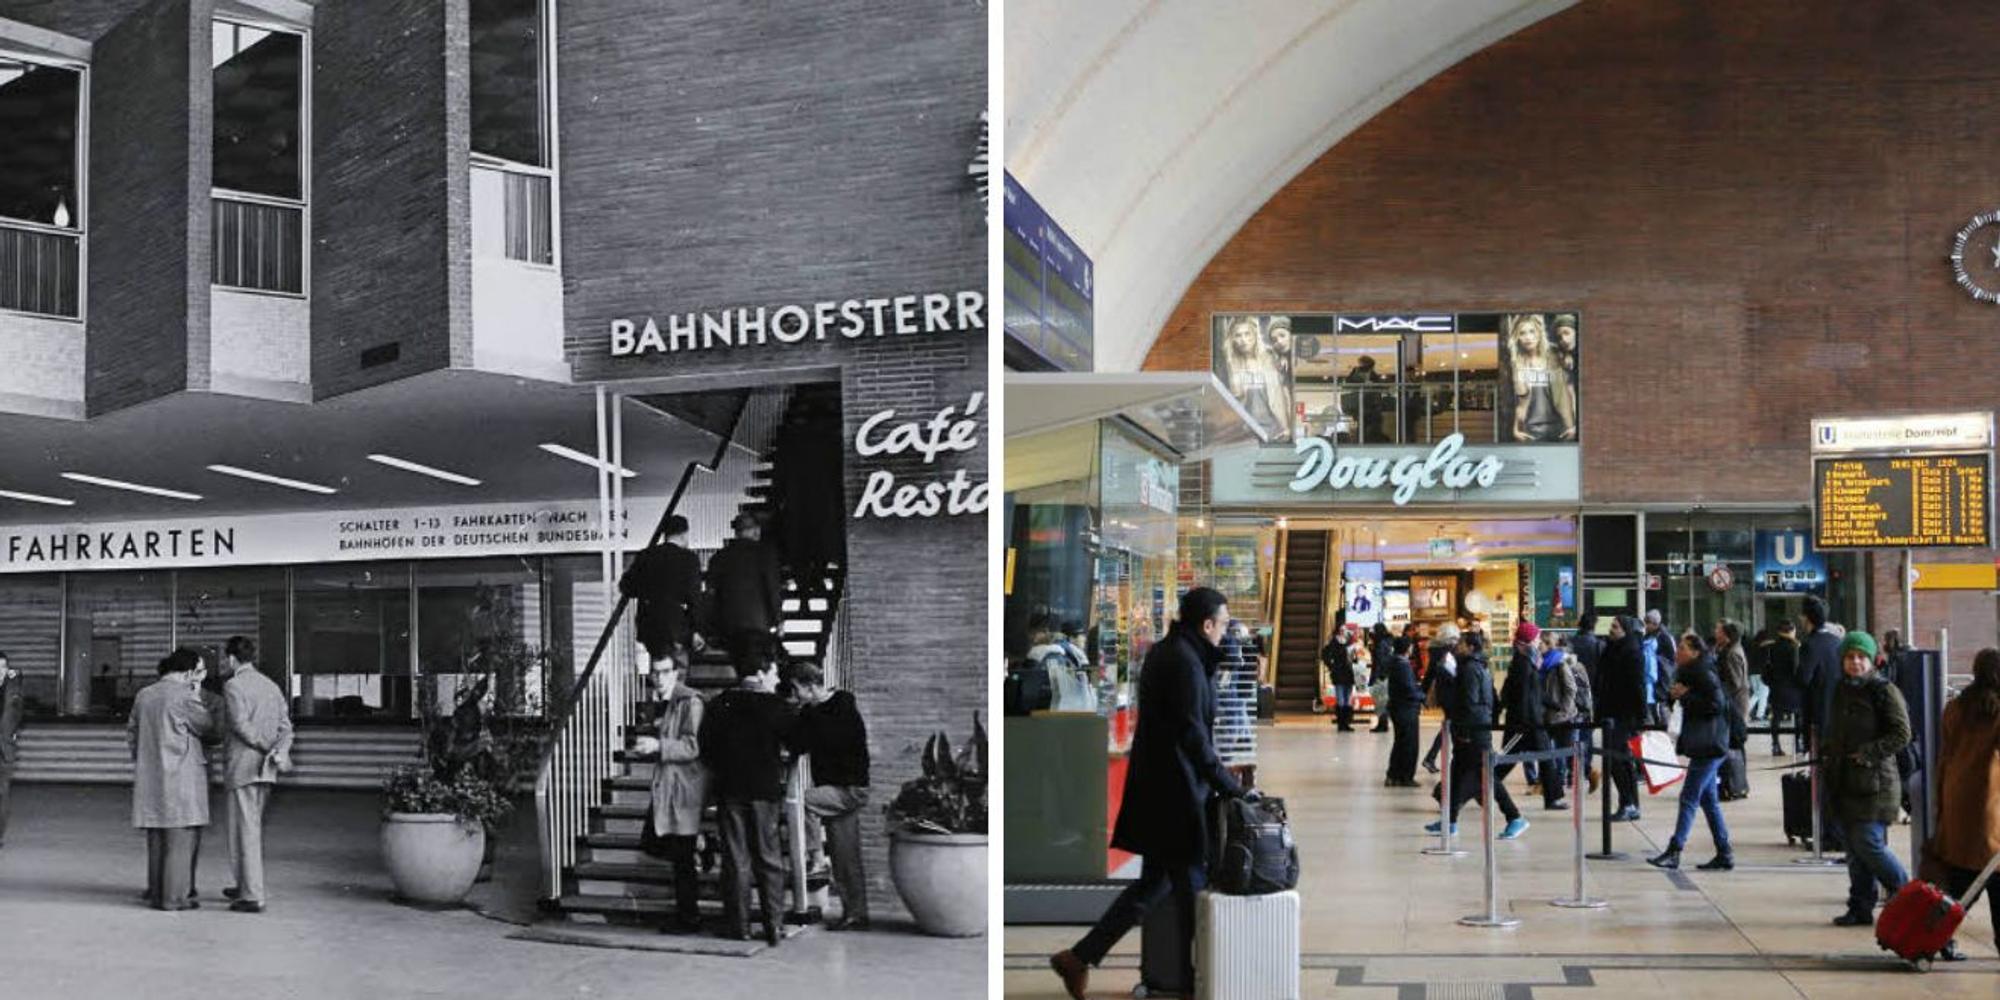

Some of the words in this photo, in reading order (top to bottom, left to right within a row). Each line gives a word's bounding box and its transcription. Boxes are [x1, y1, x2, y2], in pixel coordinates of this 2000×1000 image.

[855, 392, 984, 463] Café
[1289, 432, 1504, 506] Douglas
[340, 519, 399, 533] SCHALTER
[453, 512, 536, 527] FAHRKARTEN
[549, 511, 587, 523] NACH
[9, 527, 234, 562] FAHRKARTEN
[421, 535, 445, 547] DER
[453, 531, 528, 545] DEUTSCHEN
[1775, 535, 1804, 566] U
